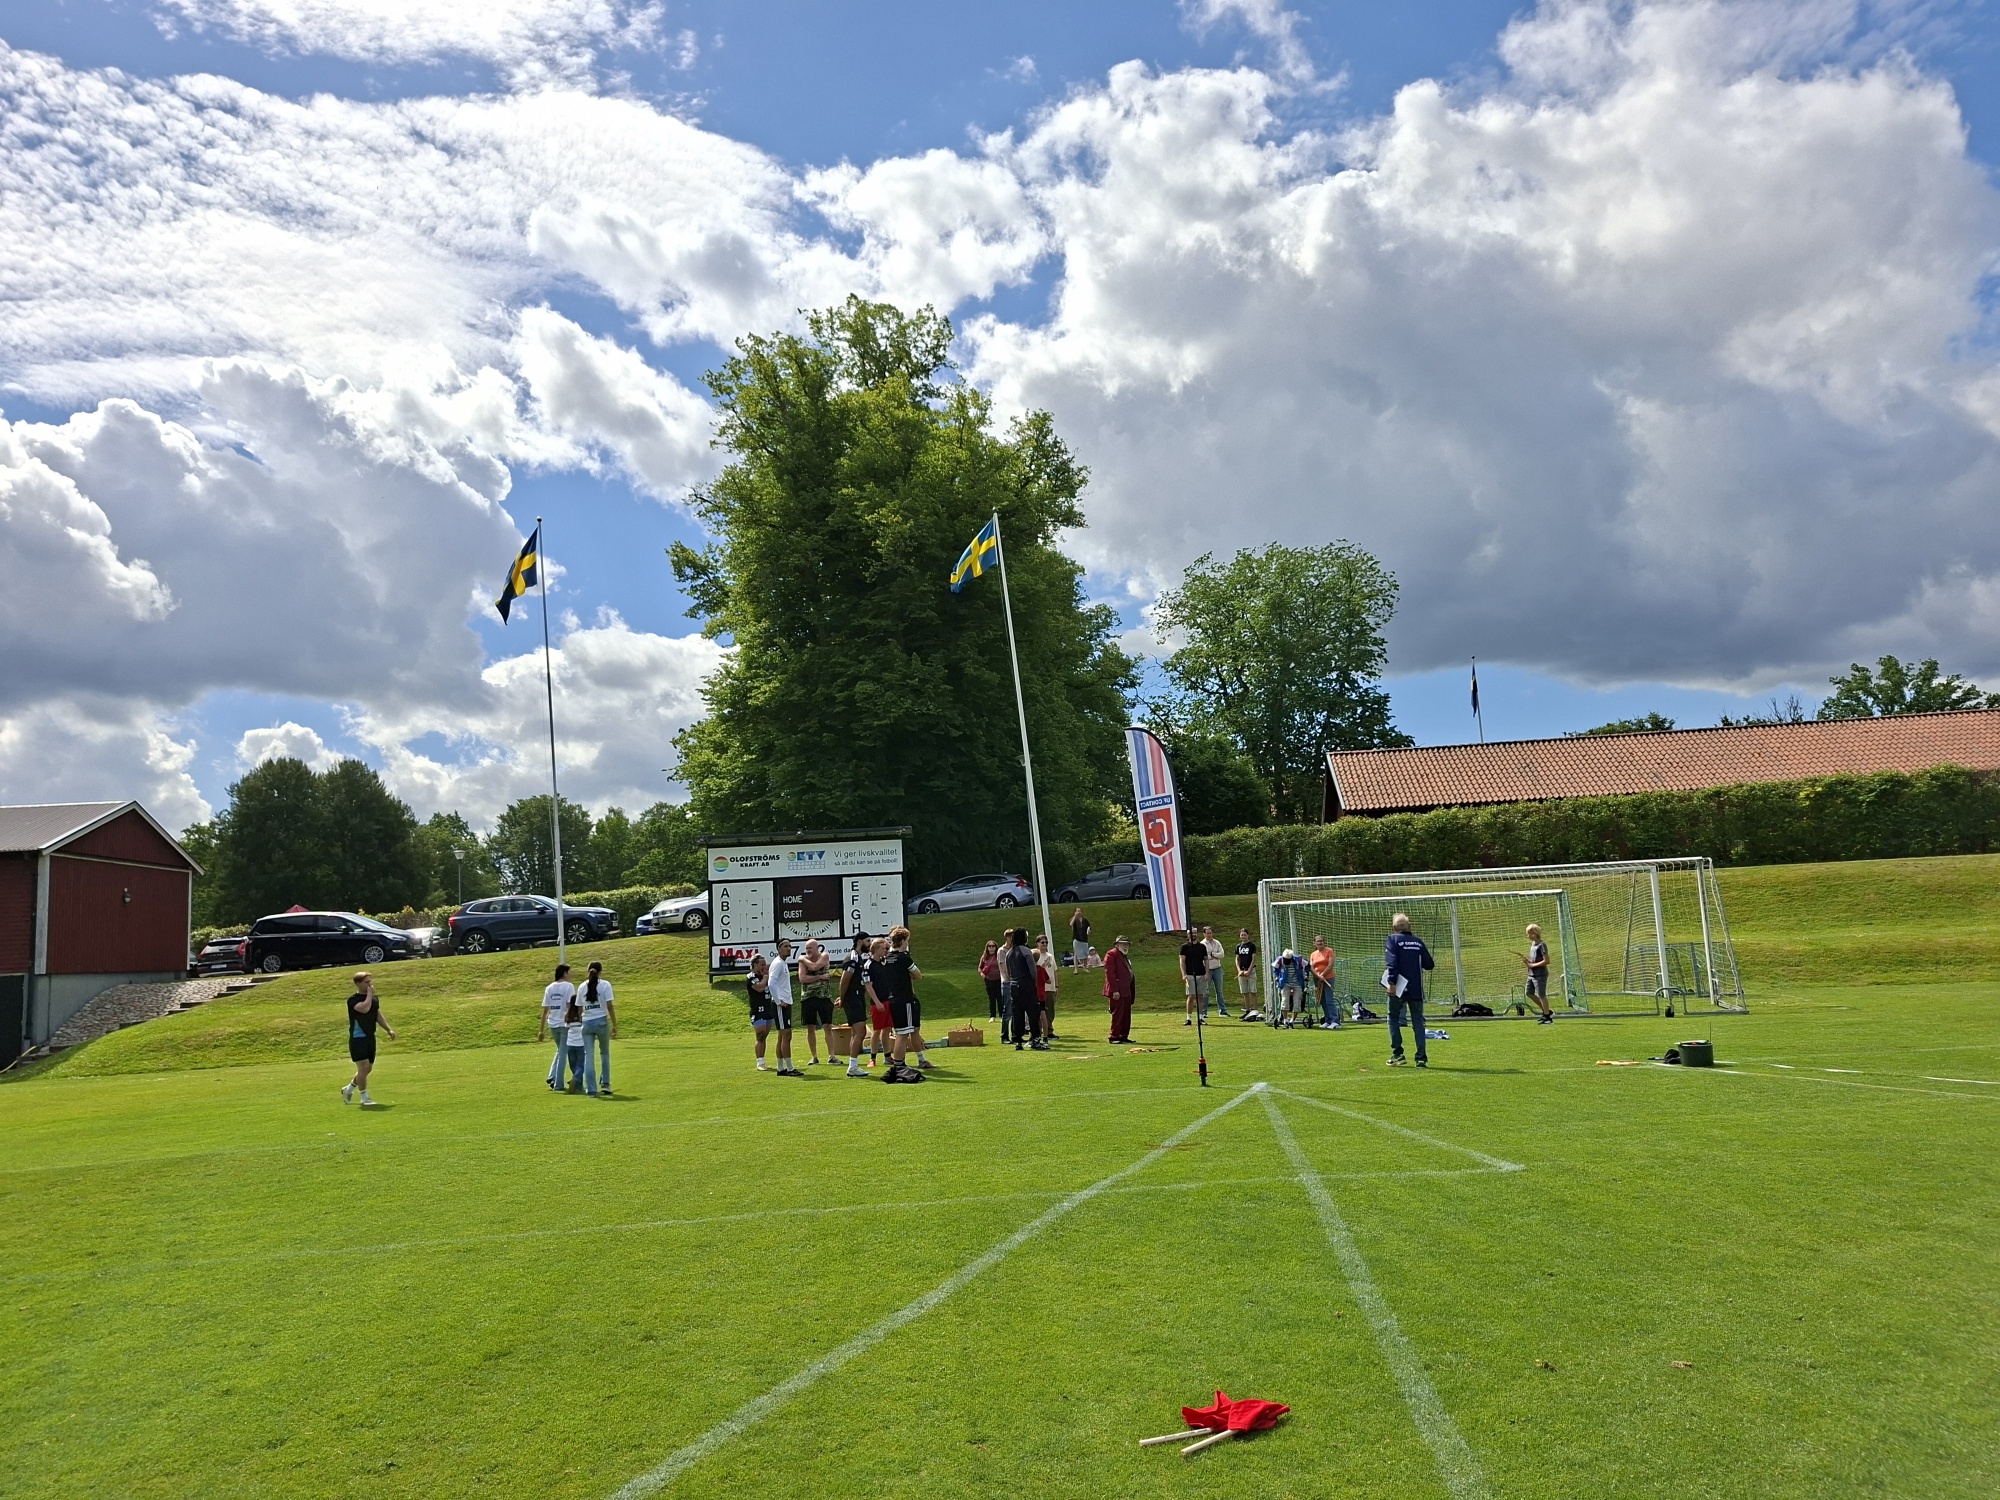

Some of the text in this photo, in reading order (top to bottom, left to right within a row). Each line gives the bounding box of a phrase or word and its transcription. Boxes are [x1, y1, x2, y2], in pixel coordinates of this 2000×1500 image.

[729, 854, 780, 863] OLOFSTRÖMS
[834, 848, 897, 859] Vi ger livskvalitet
[851, 880, 860, 892] E
[720, 887, 730, 898] A
[782, 895, 803, 904] HOME
[851, 894, 860, 905] F
[720, 901, 730, 912] B
[783, 909, 803, 919] GUEST
[851, 908, 861, 920] G
[720, 914, 730, 926] C
[852, 922, 861, 934] H
[721, 929, 731, 940] D
[720, 947, 759, 960] MAXI
[827, 947, 843, 955] varje
[1238, 946, 1250, 955] Lee
